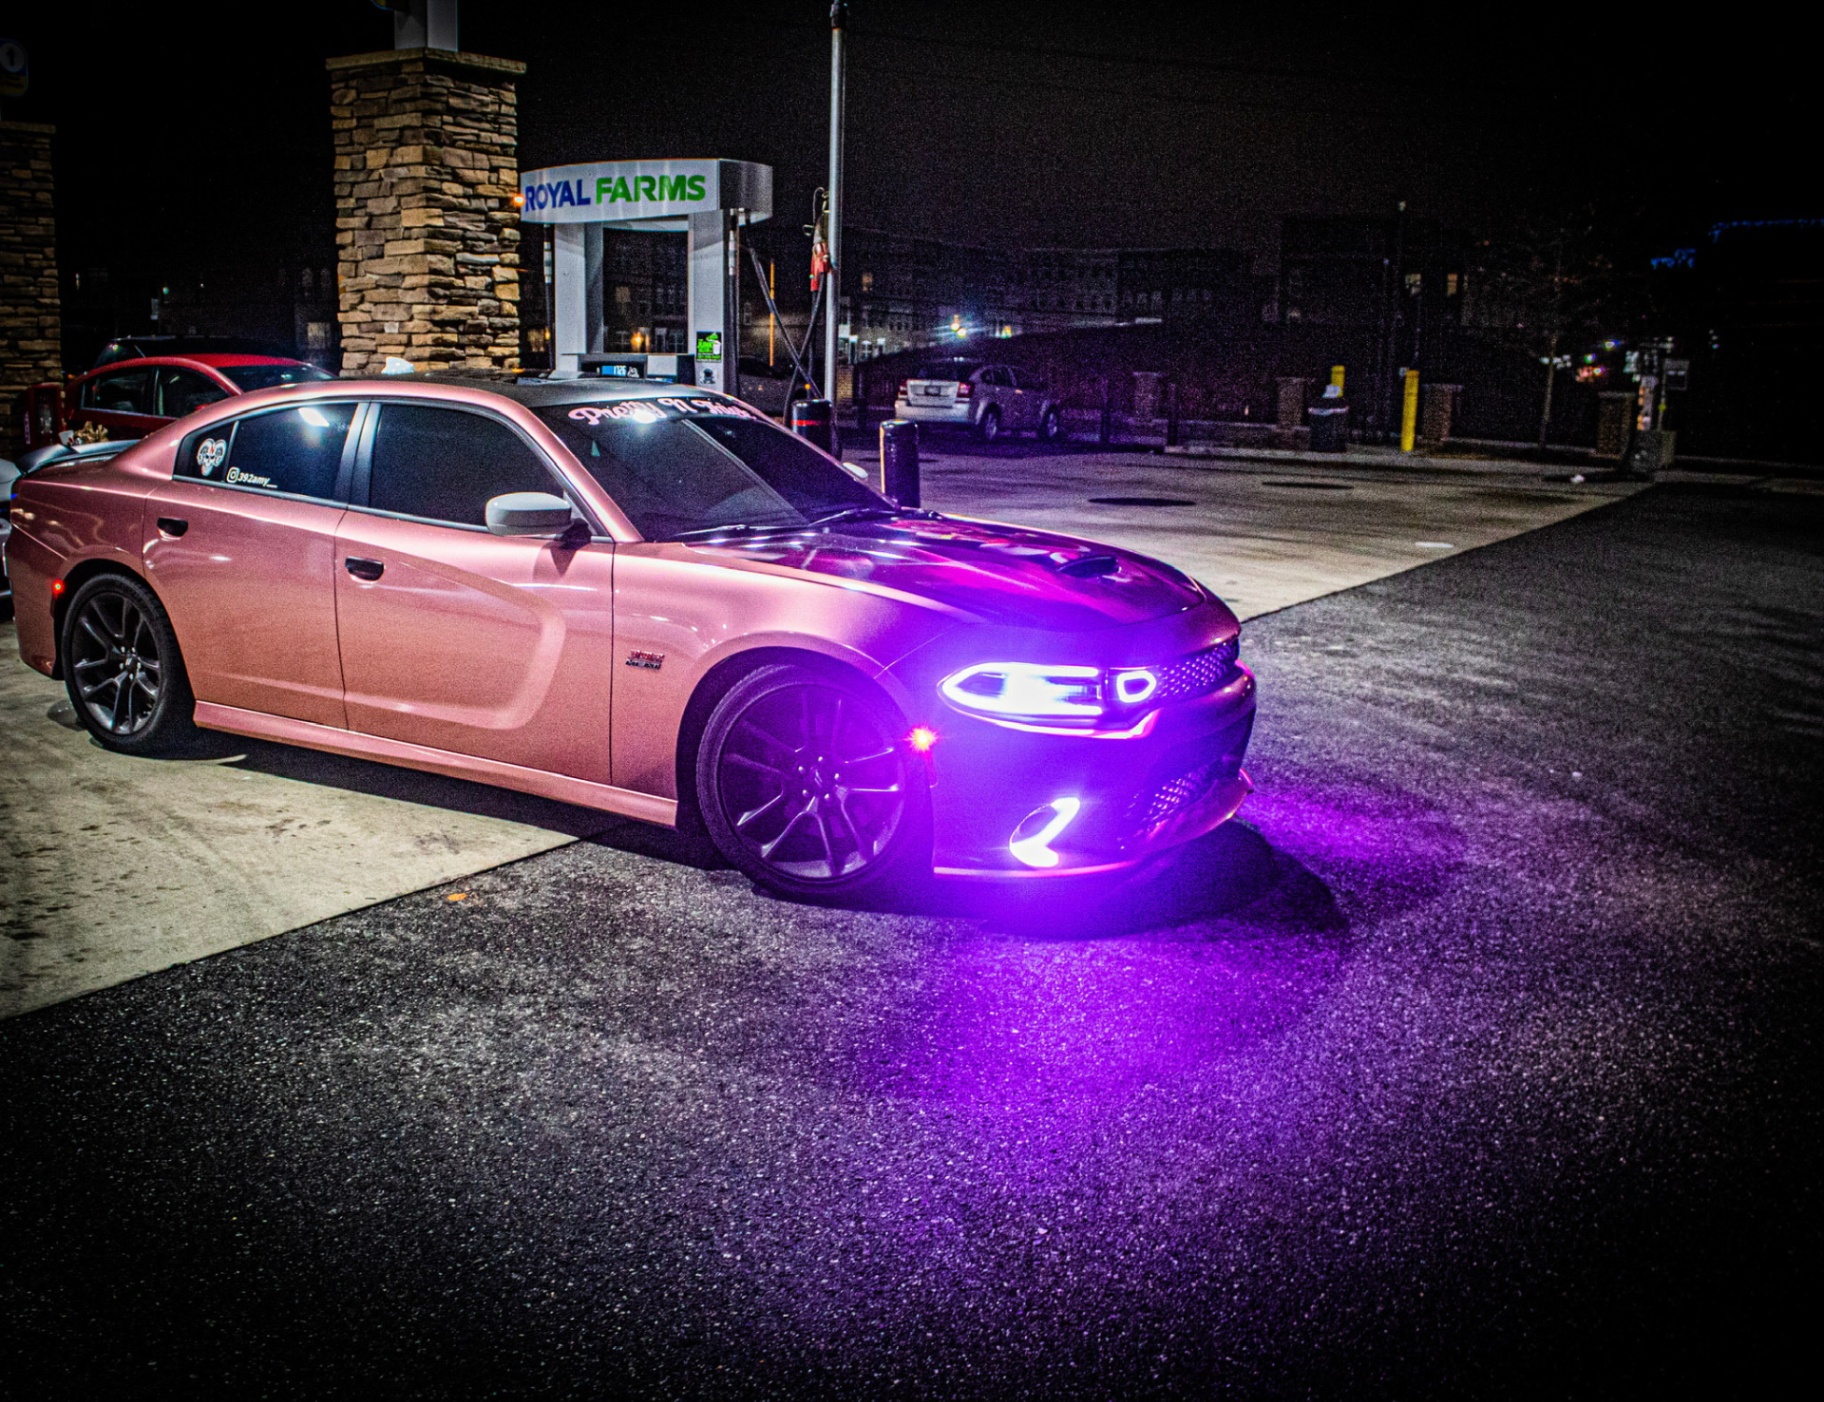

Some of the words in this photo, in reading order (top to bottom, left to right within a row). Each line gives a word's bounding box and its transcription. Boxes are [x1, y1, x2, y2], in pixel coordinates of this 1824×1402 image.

[6, 47, 15, 66] 1
[525, 179, 591, 212] ROYAL
[596, 174, 706, 205] FARMS
